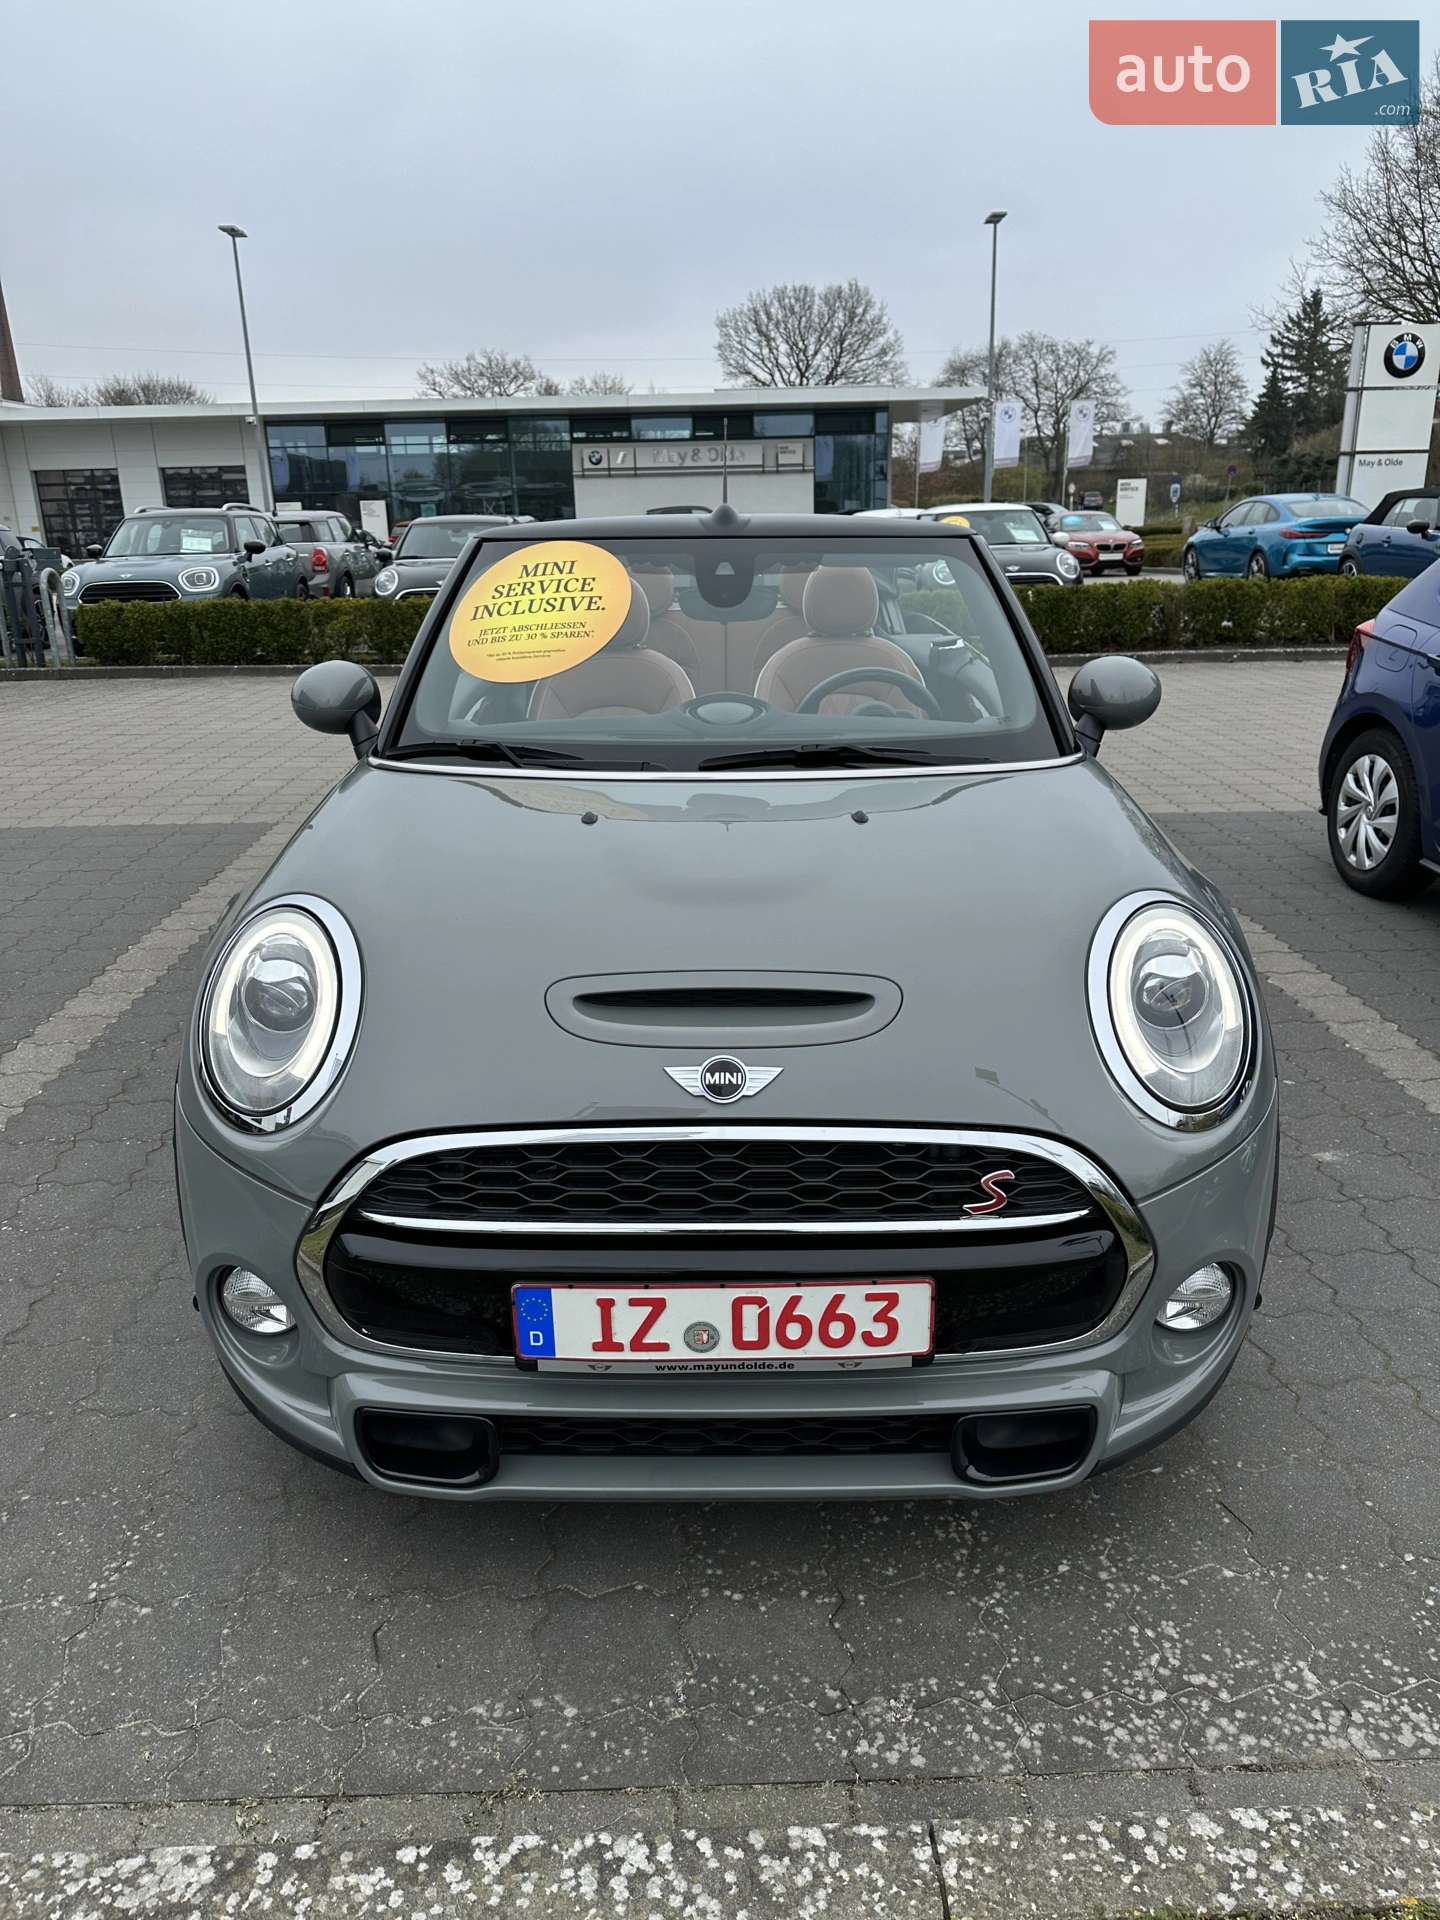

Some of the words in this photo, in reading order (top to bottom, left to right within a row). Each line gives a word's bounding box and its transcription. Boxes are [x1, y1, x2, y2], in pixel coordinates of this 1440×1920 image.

[1390, 333, 1424, 349] BMW
[652, 447, 687, 466] May
[691, 447, 702, 462] &
[1358, 458, 1375, 469] May
[1377, 458, 1383, 467] &
[1384, 458, 1403, 467] Olde
[518, 560, 578, 579] MINI
[491, 577, 596, 600] SERVICE
[470, 596, 606, 621] INCLUSIVE.
[478, 626, 508, 638] JETZT
[509, 621, 587, 633] ABSCHLIESSEN
[467, 638, 488, 647] UND
[490, 635, 507, 644] BIS
[508, 633, 523, 642] ZU
[525, 633, 538, 641] 30
[540, 632, 548, 640] %
[705, 1072, 742, 1085] MINI
[963, 1169, 1015, 1214] S
[591, 1296, 670, 1352] IZ
[731, 1291, 900, 1351] 0663
[529, 1330, 544, 1347] D
[655, 1361, 795, 1372] www.mayundolde.de
